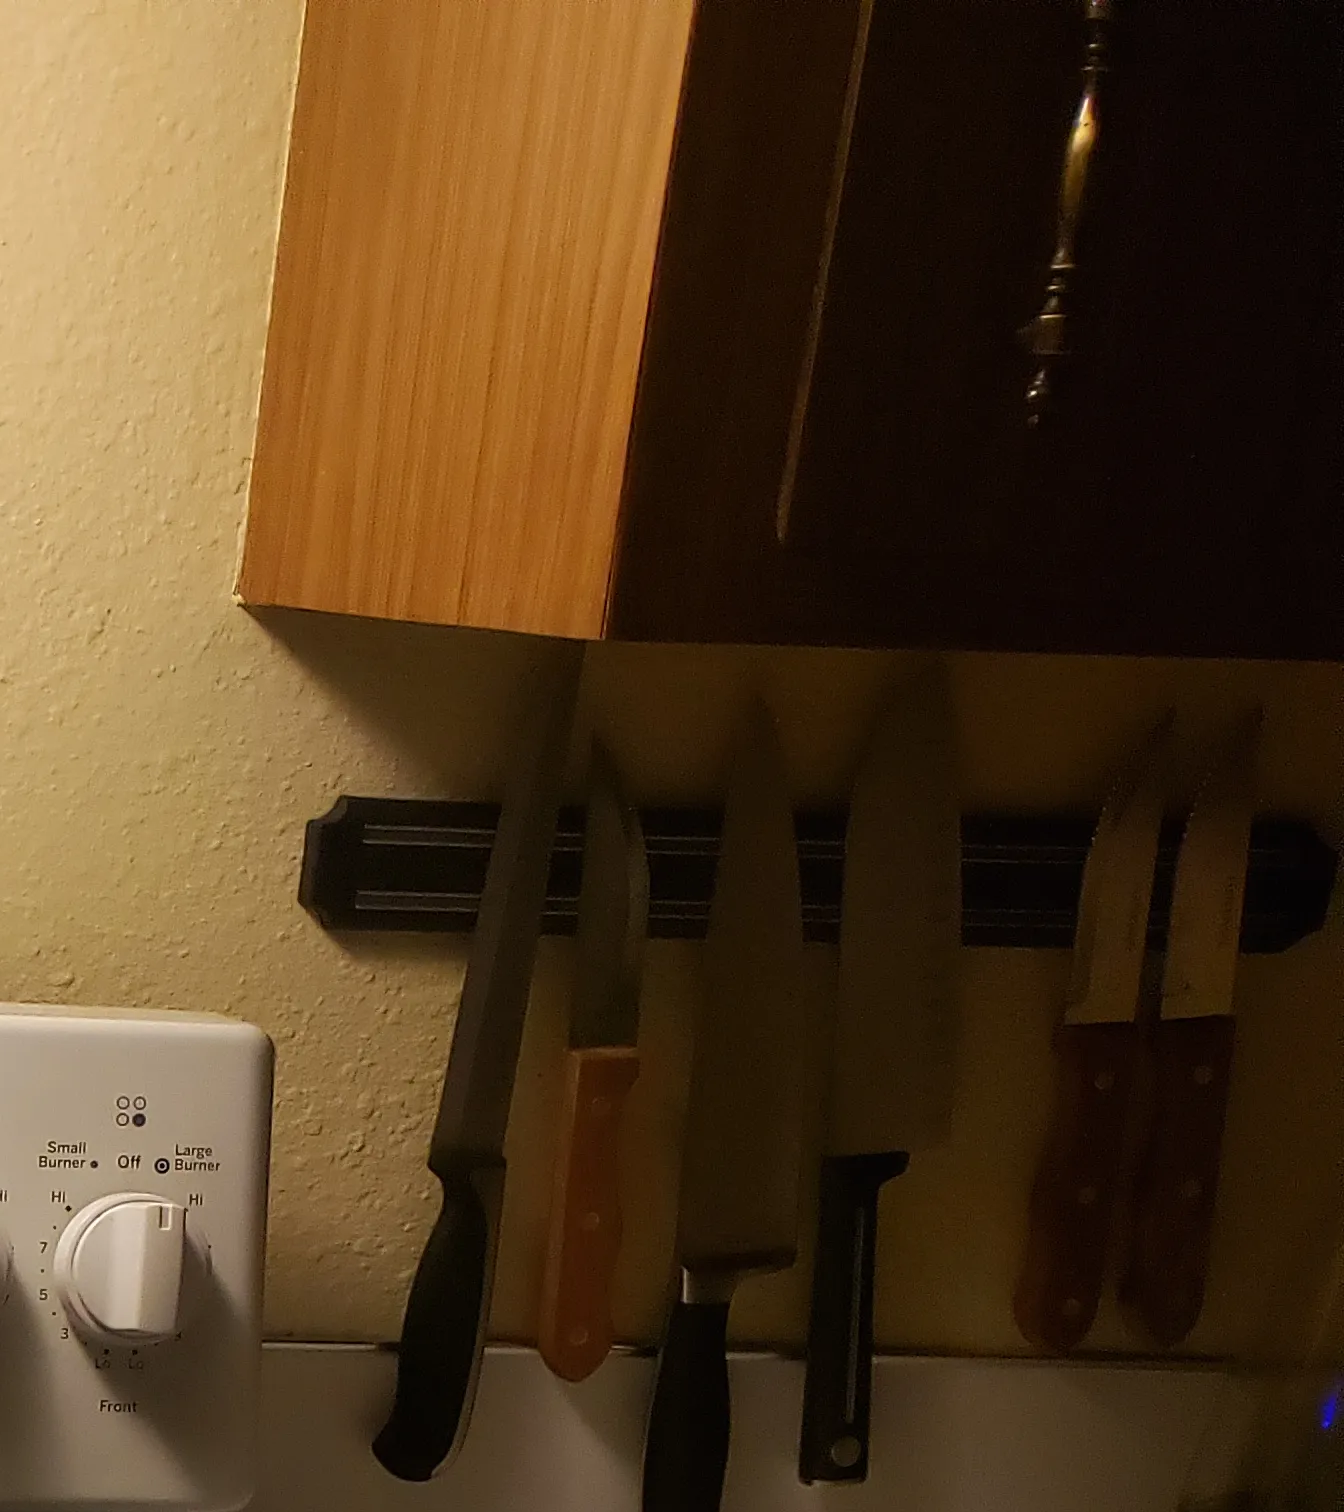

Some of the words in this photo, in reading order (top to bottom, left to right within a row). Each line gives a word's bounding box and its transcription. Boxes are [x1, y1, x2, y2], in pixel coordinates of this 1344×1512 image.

[47, 1140, 87, 1154] Small
[175, 1144, 213, 1159] Large
[38, 1156, 86, 1170] Burner
[117, 1155, 141, 1170] Off
[174, 1159, 221, 1172] Burner
[51, 1191, 66, 1204] Hi
[188, 1194, 203, 1206] Hi
[39, 1242, 48, 1254] 7
[39, 1289, 48, 1301] 5
[60, 1328, 69, 1340] 3
[99, 1400, 137, 1413] Front
